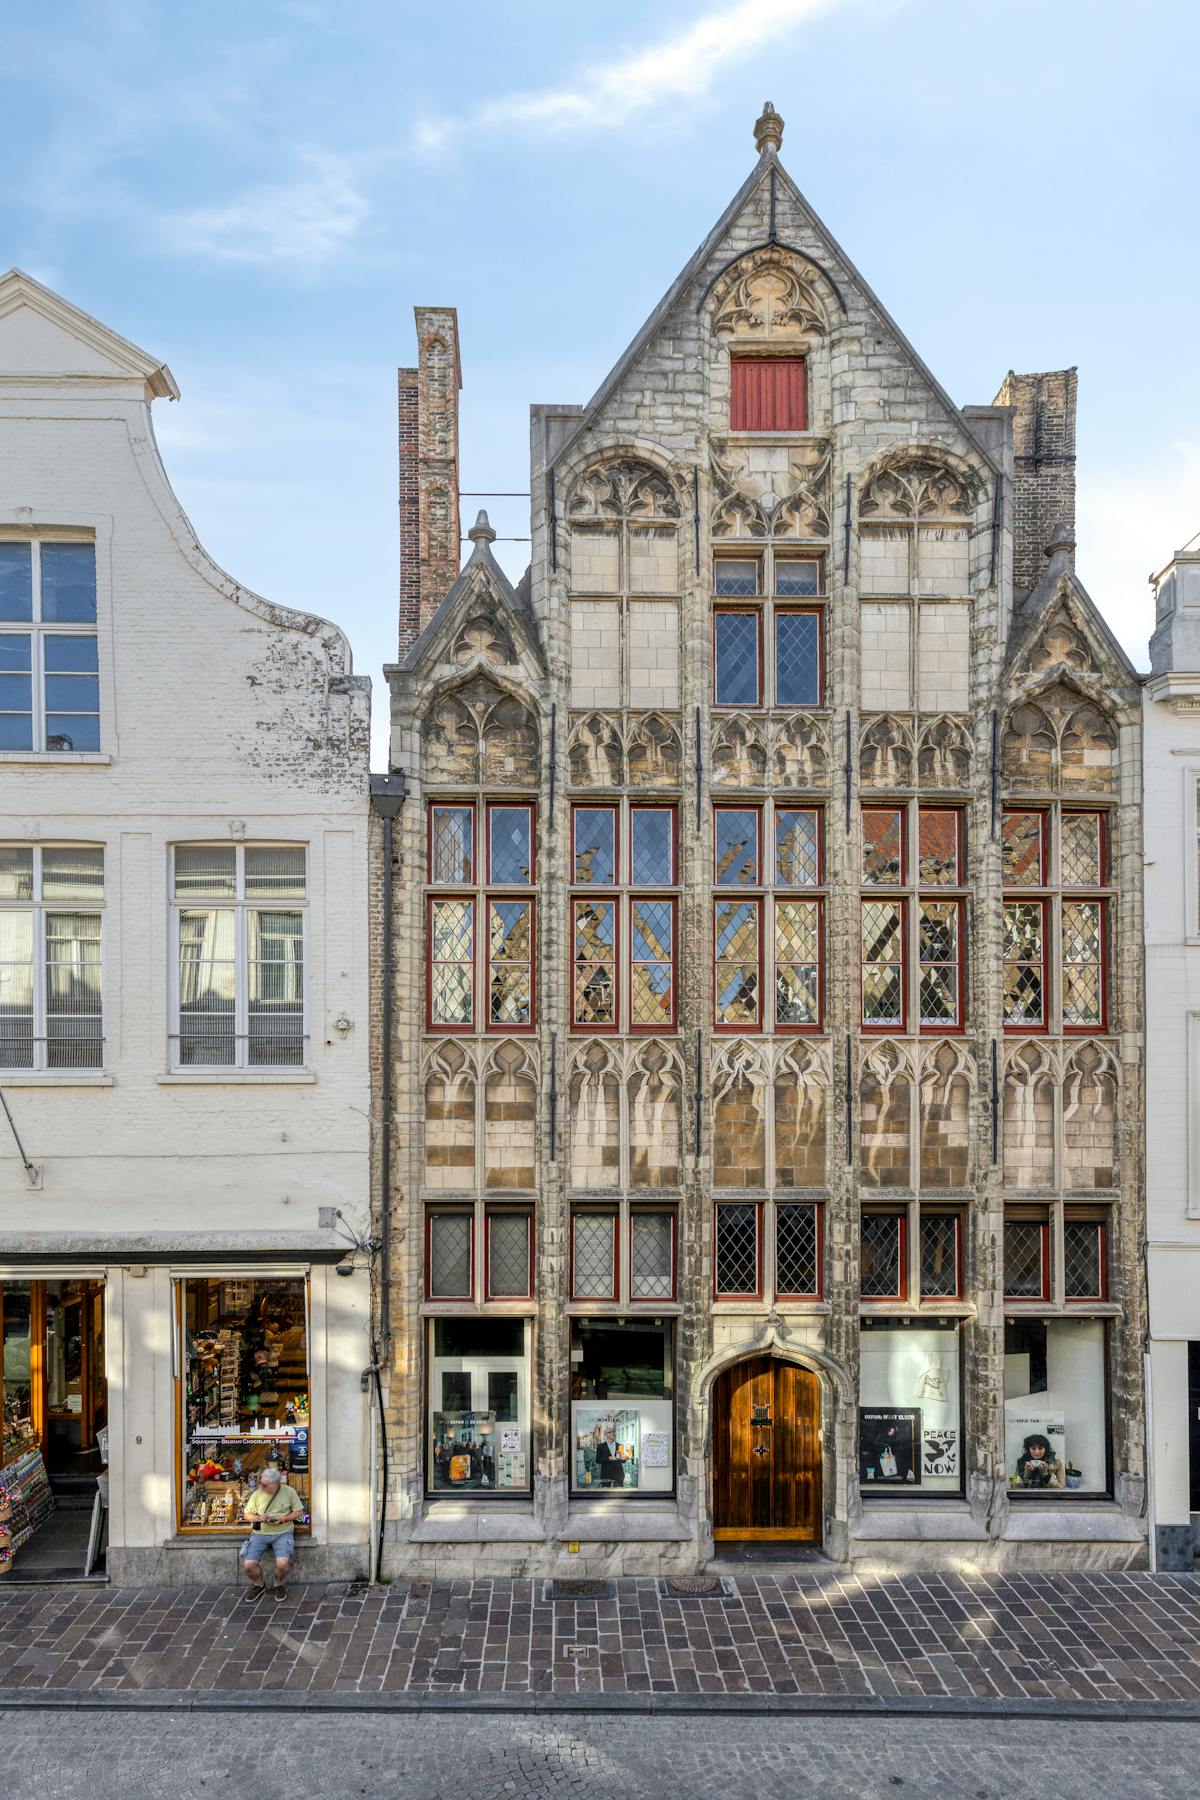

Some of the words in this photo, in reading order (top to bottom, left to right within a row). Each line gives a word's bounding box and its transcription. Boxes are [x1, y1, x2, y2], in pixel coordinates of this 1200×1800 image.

[923, 1430, 956, 1439] PEACE
[136, 1435, 142, 1445] 9
[924, 1463, 956, 1474] NOW
